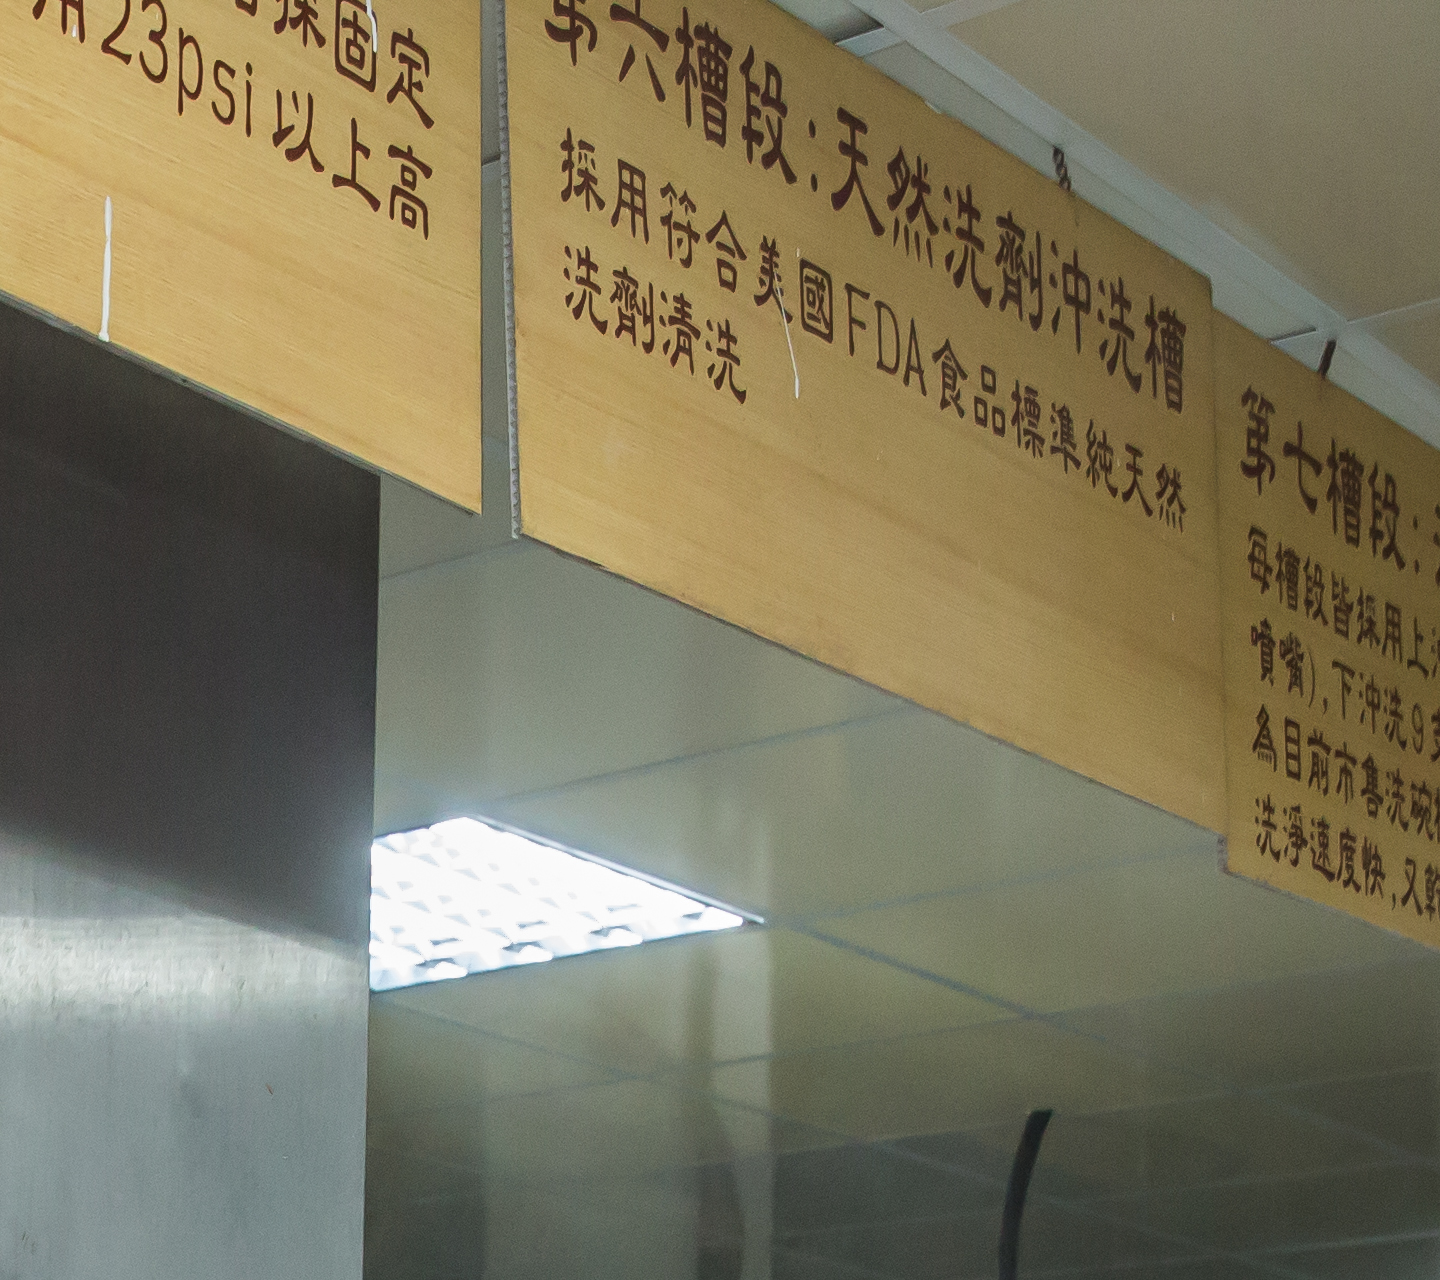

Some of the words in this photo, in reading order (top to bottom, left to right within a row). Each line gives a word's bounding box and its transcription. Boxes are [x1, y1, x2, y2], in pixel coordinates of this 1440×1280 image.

[560, 128, 1185, 532] 採用符合美國FDA食品標準純天然
[563, 245, 747, 404] 洗劑清洗
